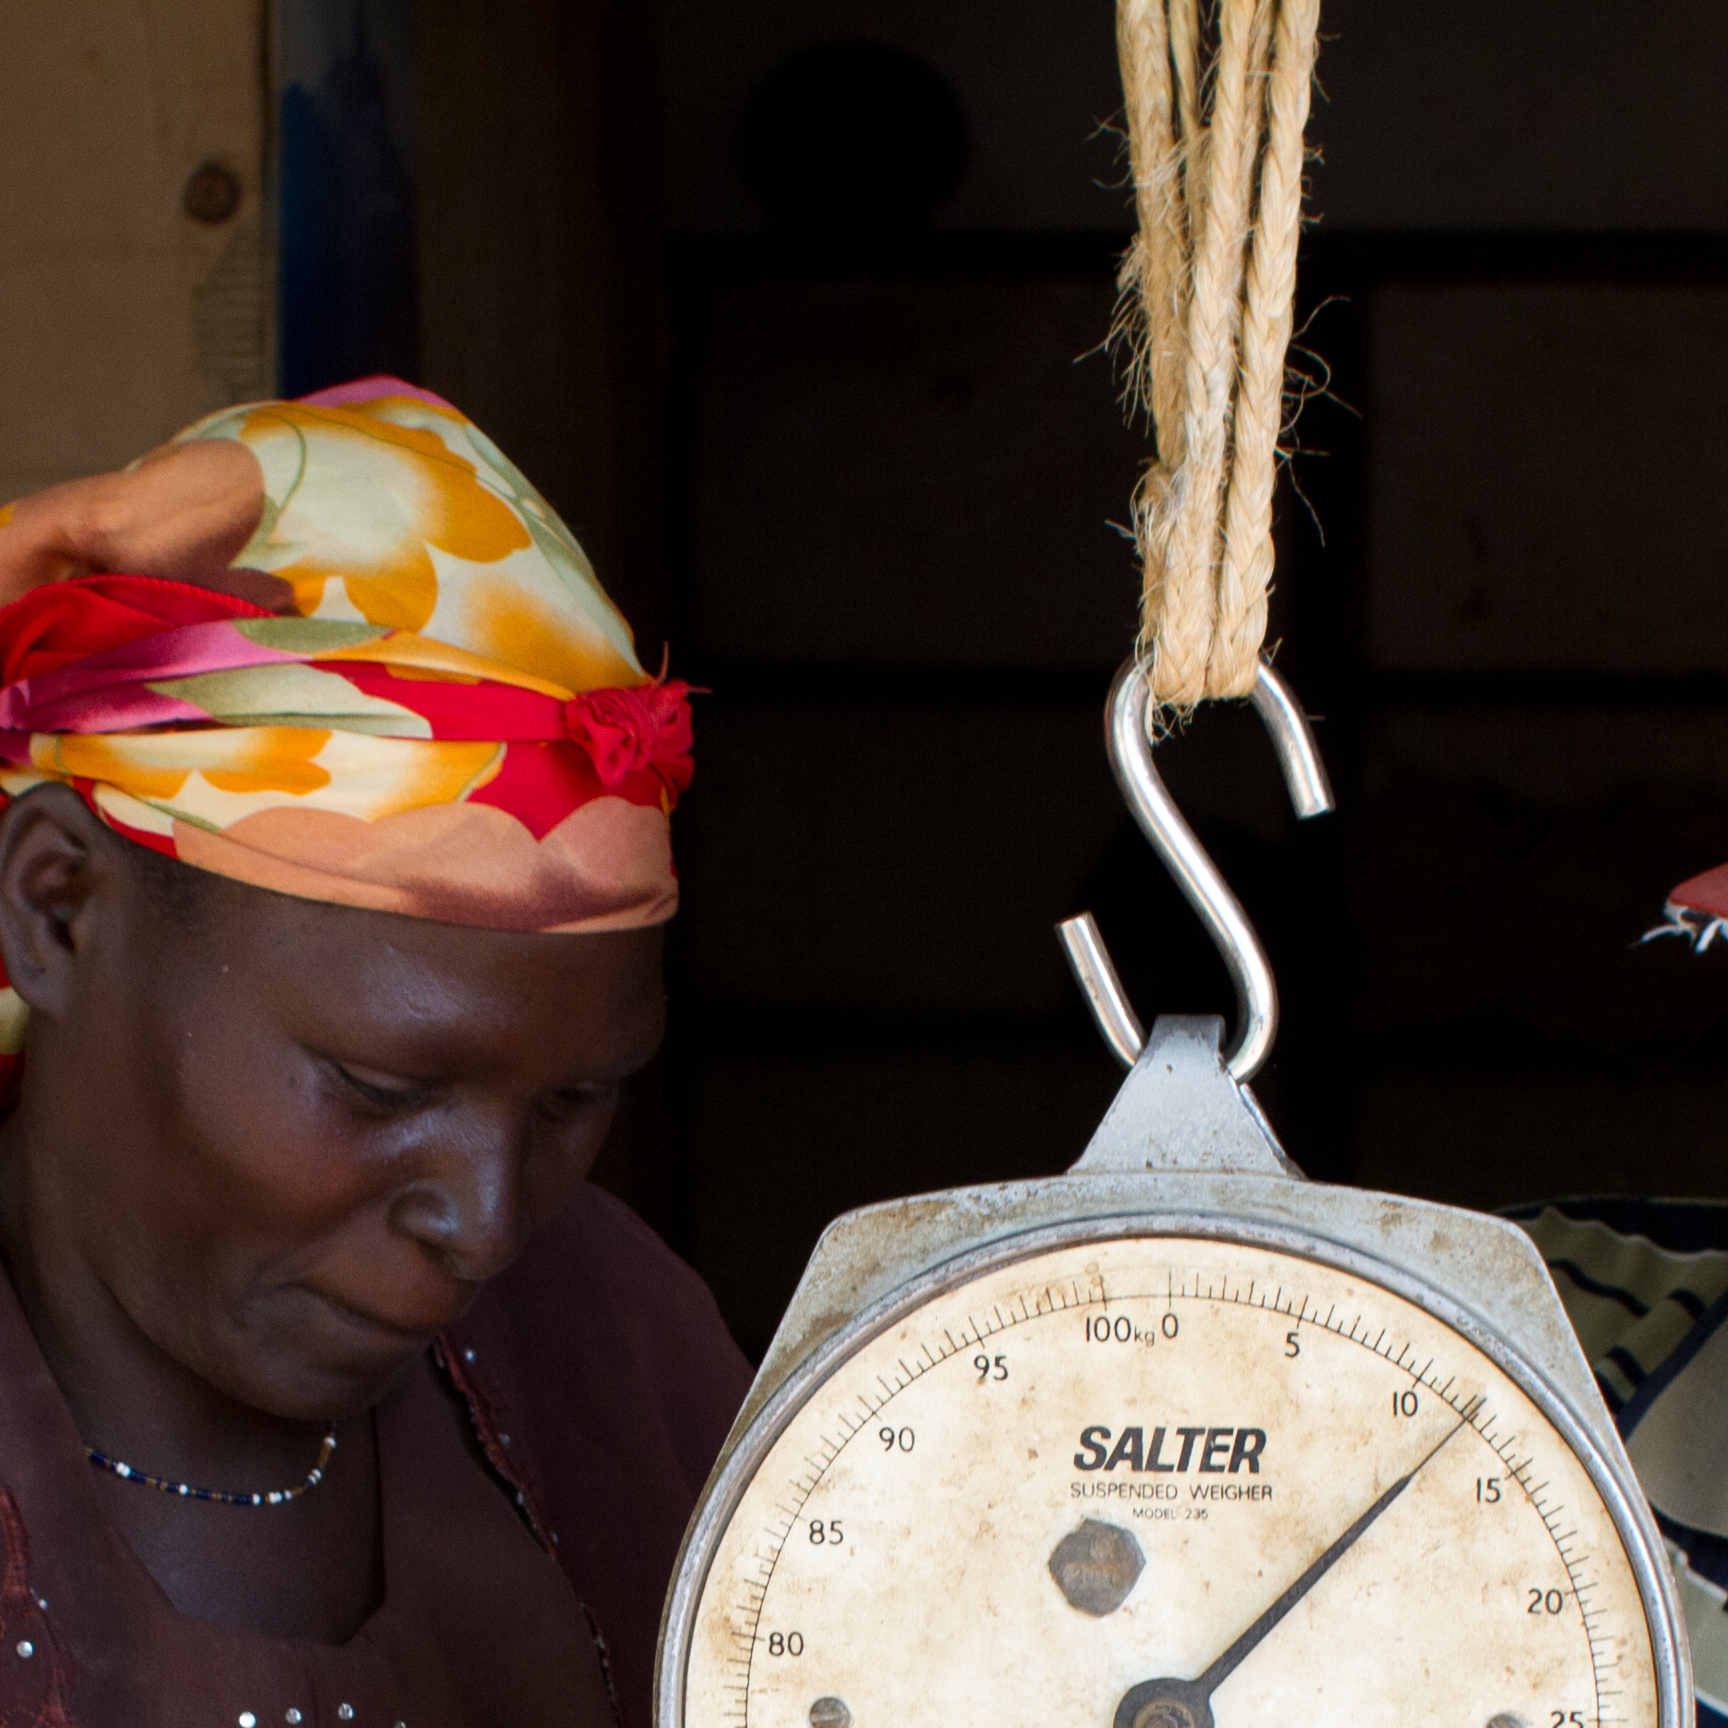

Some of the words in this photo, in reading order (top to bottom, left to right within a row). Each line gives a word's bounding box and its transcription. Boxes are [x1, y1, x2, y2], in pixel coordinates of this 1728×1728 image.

[1161, 1313, 1179, 1340] 0
[1284, 1332, 1300, 1359] 5
[973, 1355, 1009, 1382] 95
[1392, 1390, 1419, 1418] 10
[878, 1427, 915, 1453] 90
[1073, 1426, 1267, 1474] SALTER
[1070, 1481, 1179, 1500] SUSPENDED
[1189, 1484, 1273, 1502] WEIGHER
[1476, 1477, 1501, 1504] 15
[1132, 1507, 1177, 1520] MODEL
[809, 1519, 844, 1545] 85
[1527, 1588, 1564, 1615] 20
[768, 1631, 805, 1657] 80
